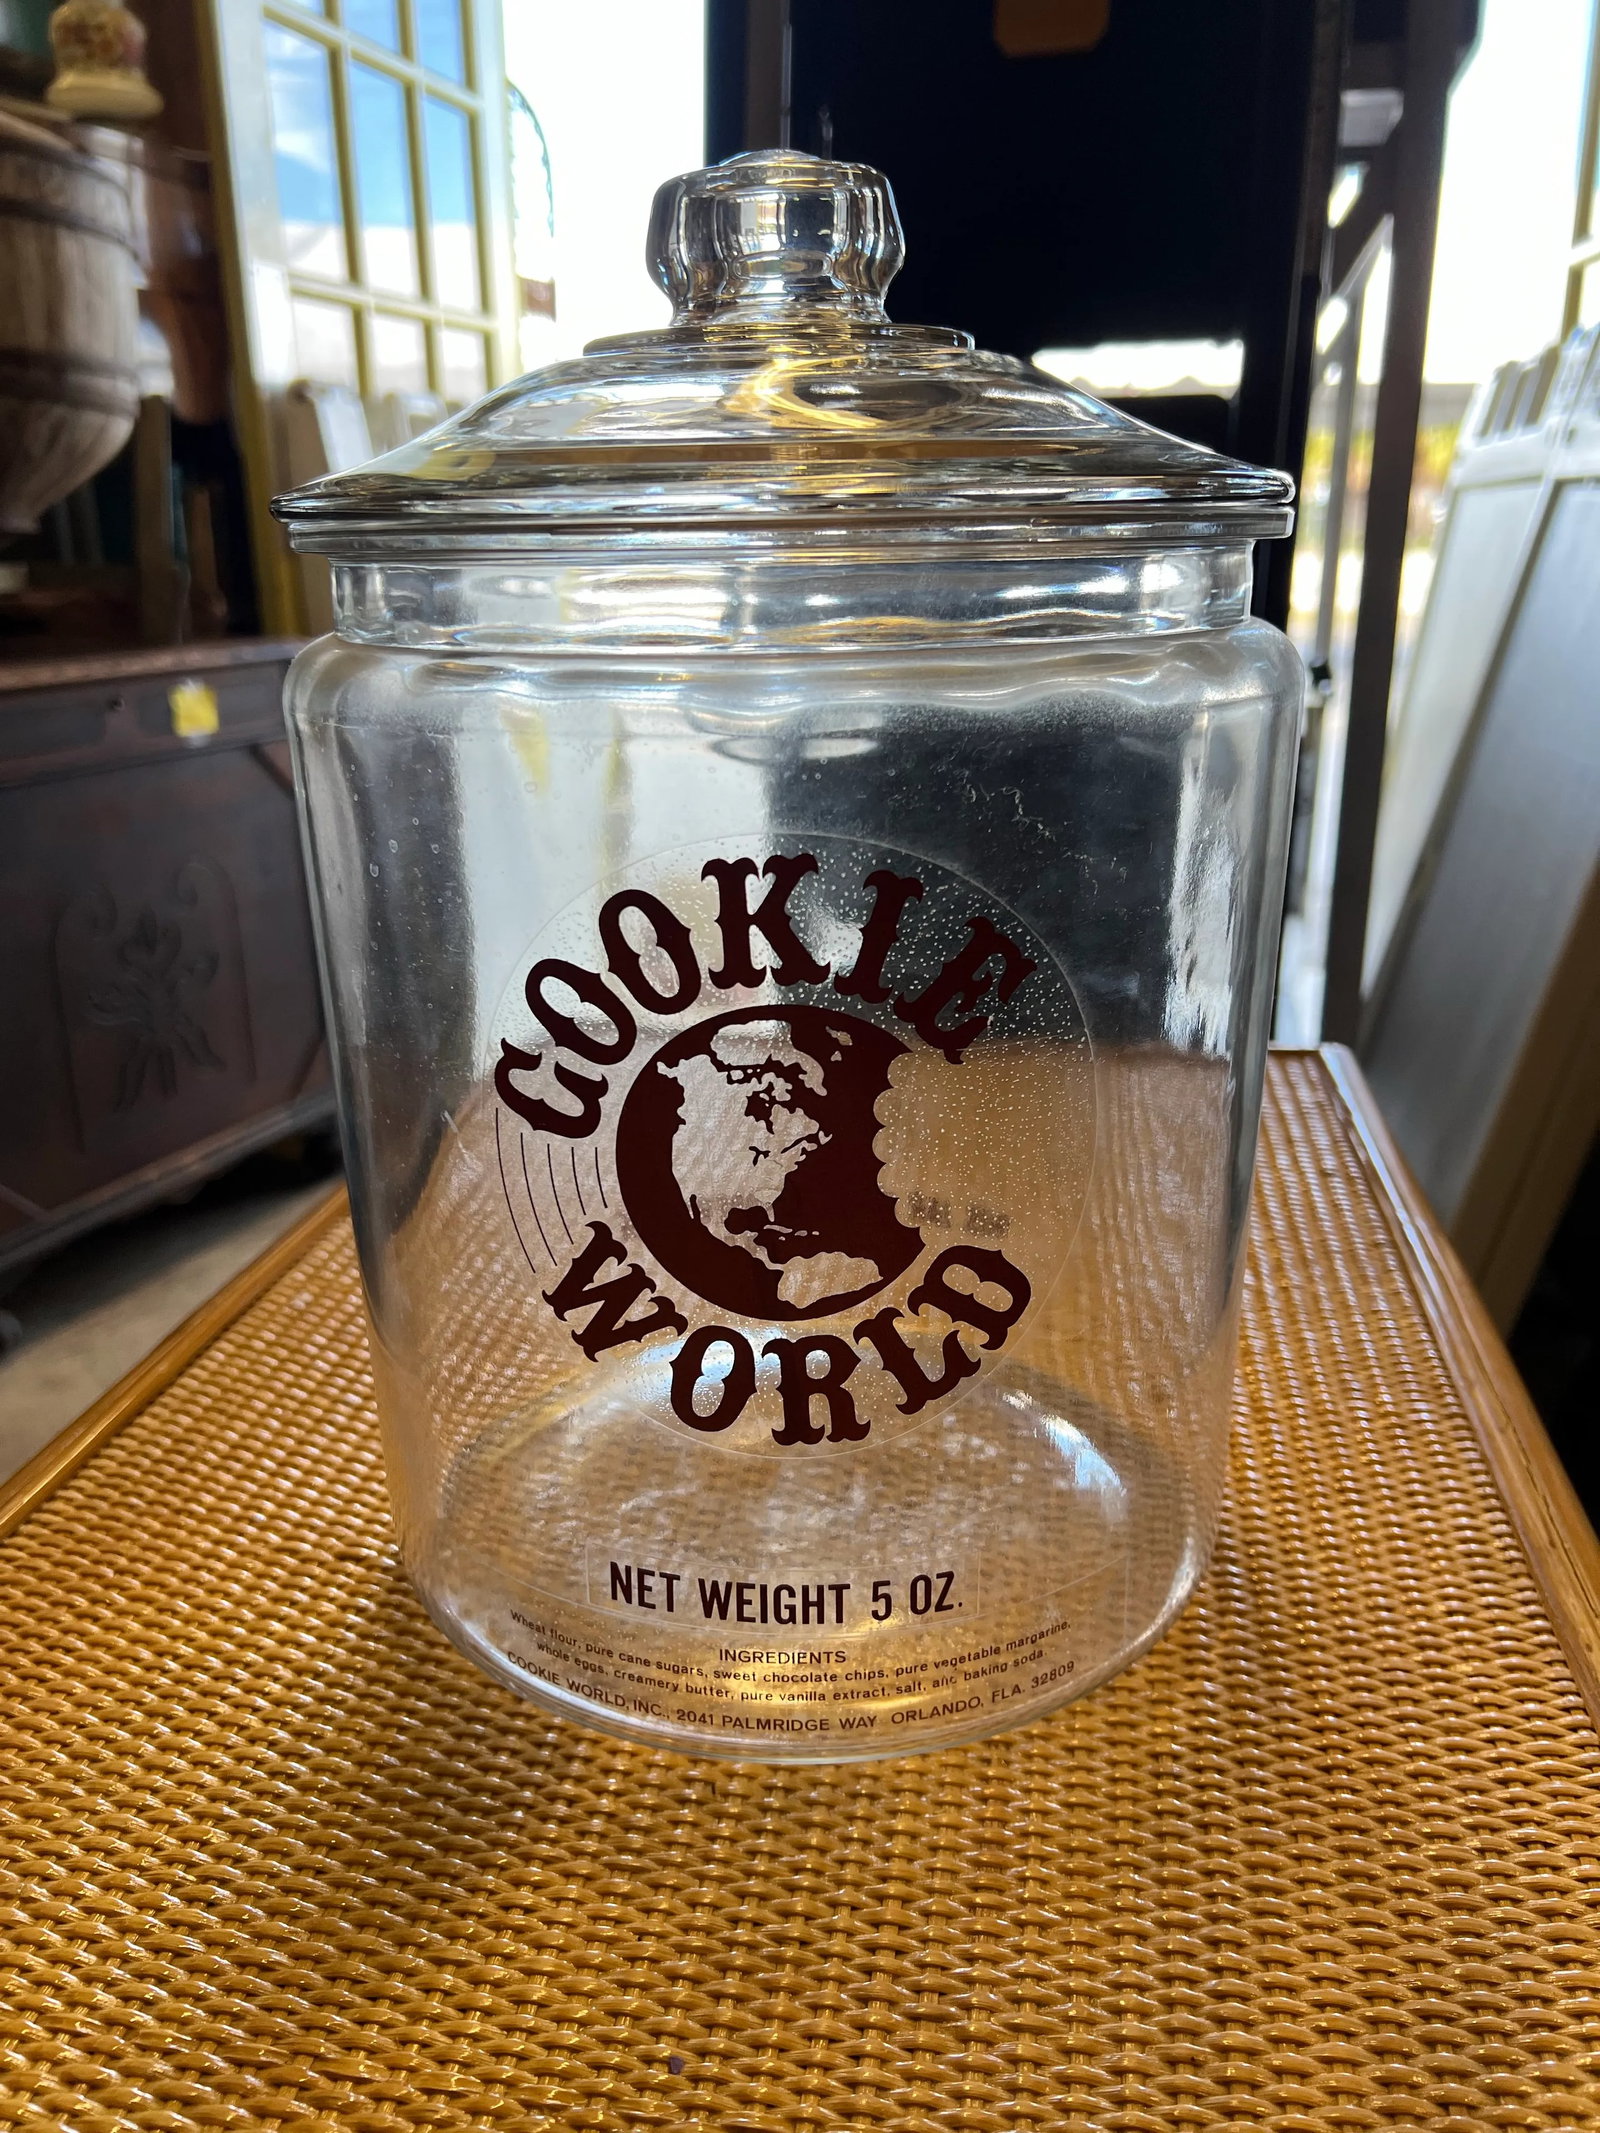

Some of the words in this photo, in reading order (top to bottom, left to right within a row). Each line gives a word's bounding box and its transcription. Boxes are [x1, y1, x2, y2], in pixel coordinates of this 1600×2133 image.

[494, 852, 1037, 1139] COOKIE
[541, 1221, 1033, 1447] WORLD
[610, 1561, 681, 1612] NET
[698, 1577, 851, 1625] WEIGHT
[871, 1580, 892, 1622] 5
[909, 1570, 963, 1616] OZ.
[510, 1609, 546, 1635] Wheat
[550, 1628, 581, 1649] flour,
[586, 1643, 614, 1659] pure
[619, 1651, 651, 1667] cane
[656, 1661, 708, 1678] sugars,
[714, 1670, 757, 1682] sweet
[763, 1671, 837, 1683] chocolate
[845, 1669, 889, 1681] chips,
[896, 1663, 928, 1677] pure
[933, 1645, 1001, 1670] vegetable
[1006, 1620, 1071, 1652] margarine,
[537, 1642, 570, 1662] whole
[574, 1658, 609, 1676] eggs,
[614, 1669, 679, 1692] creamery
[686, 1683, 734, 1700] butter,
[741, 1691, 773, 1702] pure
[779, 1691, 826, 1702] vanilla
[833, 1687, 891, 1701] extract,
[896, 1681, 927, 1695] salt,
[964, 1662, 1008, 1681] baking
[719, 1648, 847, 1665] INGREDIENTS
[507, 1651, 561, 1686] COOKIE
[566, 1677, 629, 1711] WORLD,
[677, 1709, 714, 1725] 2041
[722, 1715, 830, 1732] PALMRIDGE
[839, 1715, 878, 1730] WAY
[891, 1696, 984, 1724] ORLANDO,
[991, 1684, 1025, 1703] FLA.
[1031, 1660, 1075, 1689] 32809
